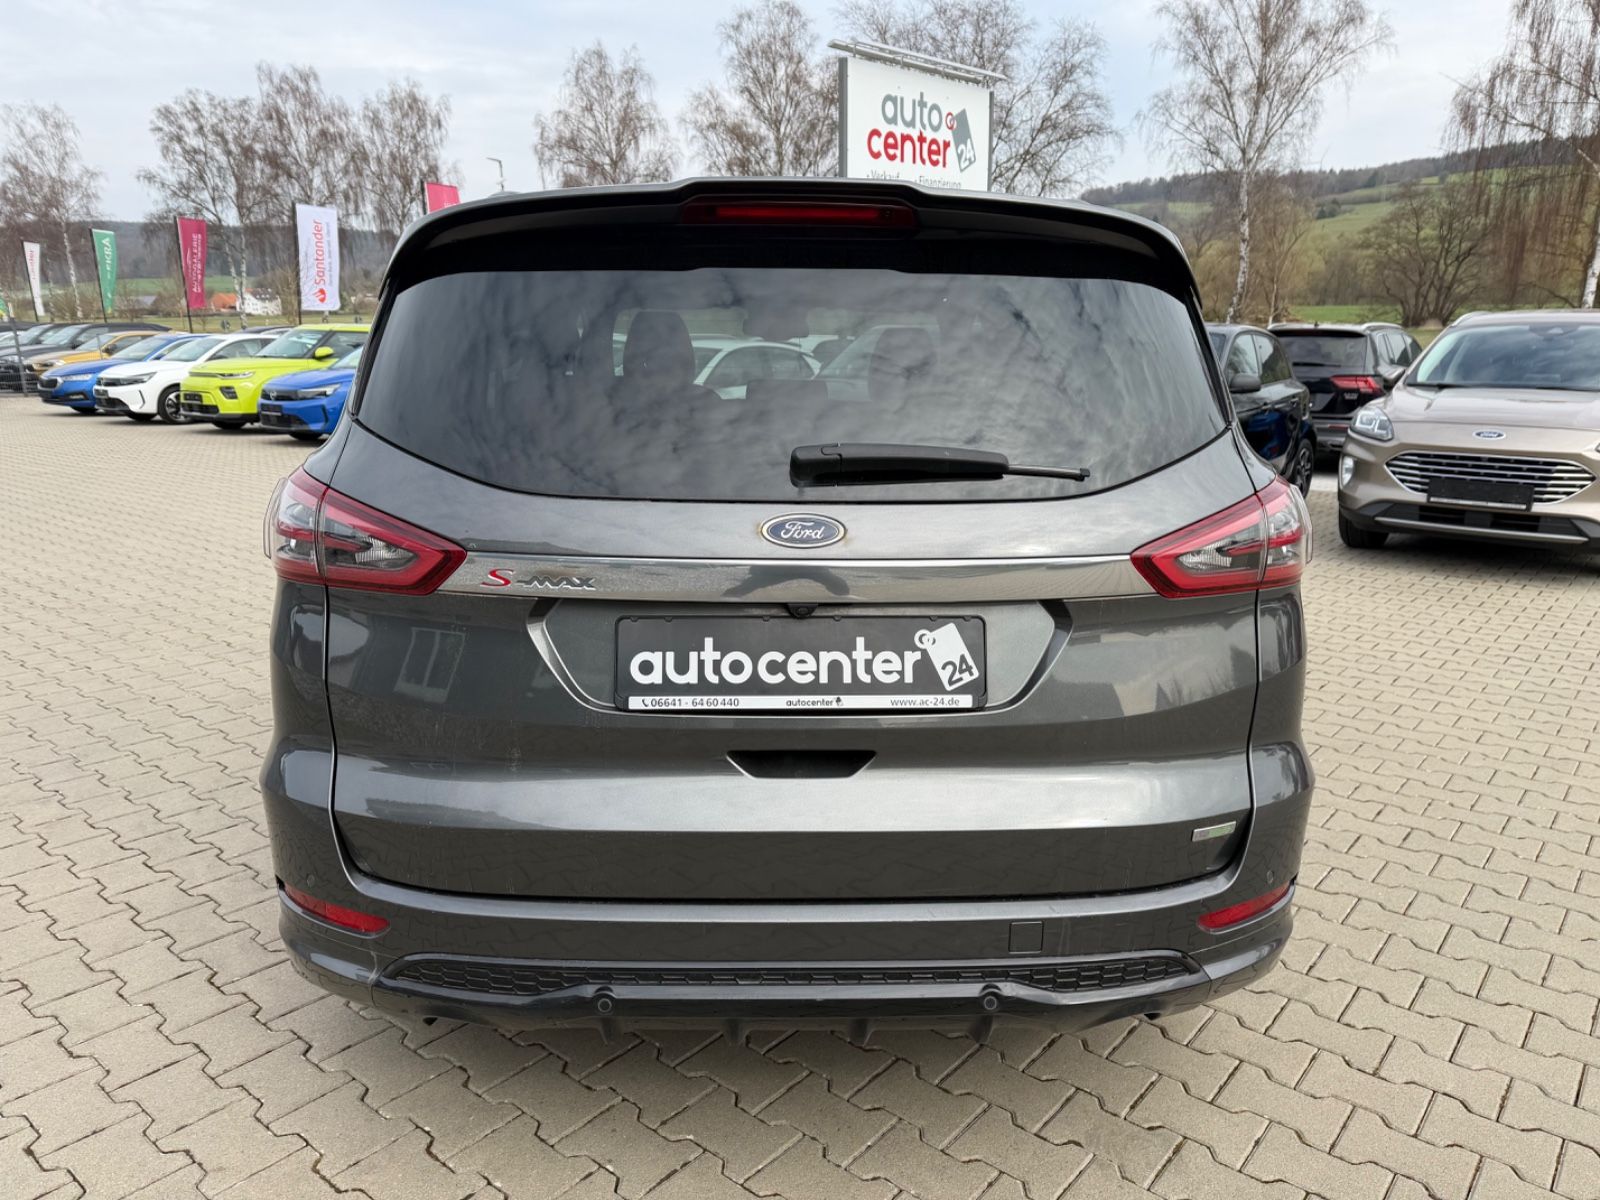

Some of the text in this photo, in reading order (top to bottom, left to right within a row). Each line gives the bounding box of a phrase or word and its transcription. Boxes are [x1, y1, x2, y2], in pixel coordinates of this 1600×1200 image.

[881, 92, 943, 132] auto
[867, 128, 951, 168] center
[958, 139, 974, 167] 24
[313, 219, 326, 286] Santander
[781, 521, 825, 539] Ford
[480, 568, 597, 591] S-MAX
[940, 653, 975, 687] 24
[650, 699, 682, 708] 06641
[785, 697, 834, 707] autocenter
[890, 697, 960, 706] www.ac-24.de
